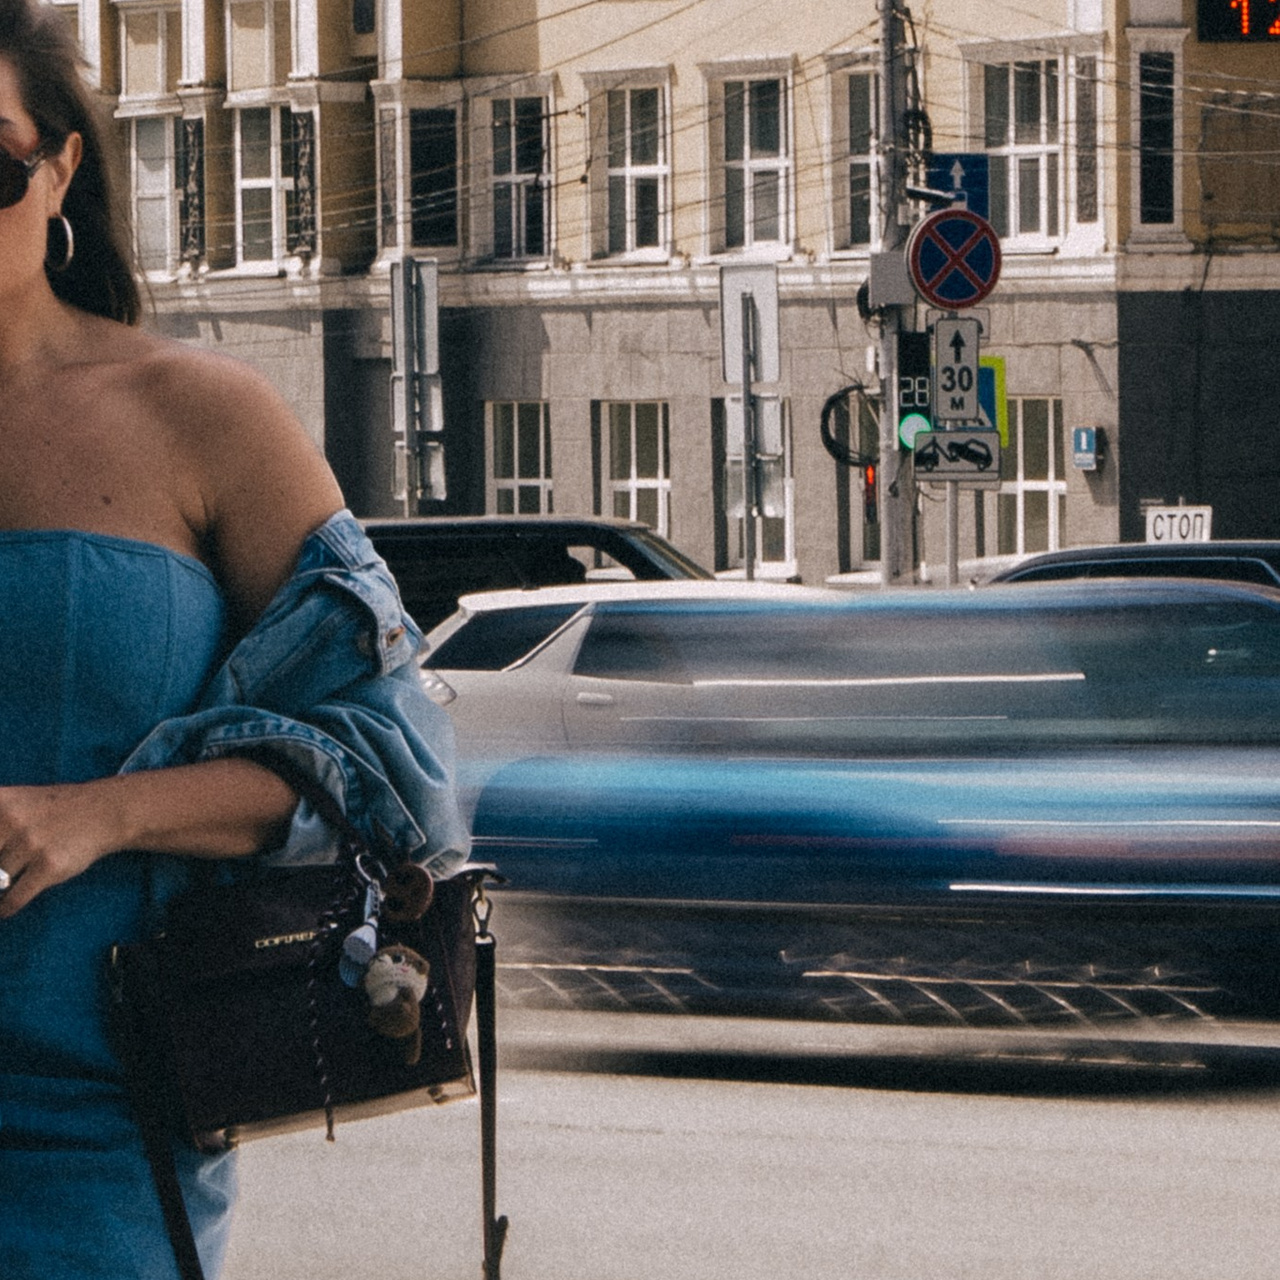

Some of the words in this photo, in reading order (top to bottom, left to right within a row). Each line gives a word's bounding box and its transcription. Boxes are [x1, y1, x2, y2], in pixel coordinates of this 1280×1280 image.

[899, 376, 930, 407] 28
[941, 365, 974, 392] 30
[1152, 513, 1205, 541] СТОП
